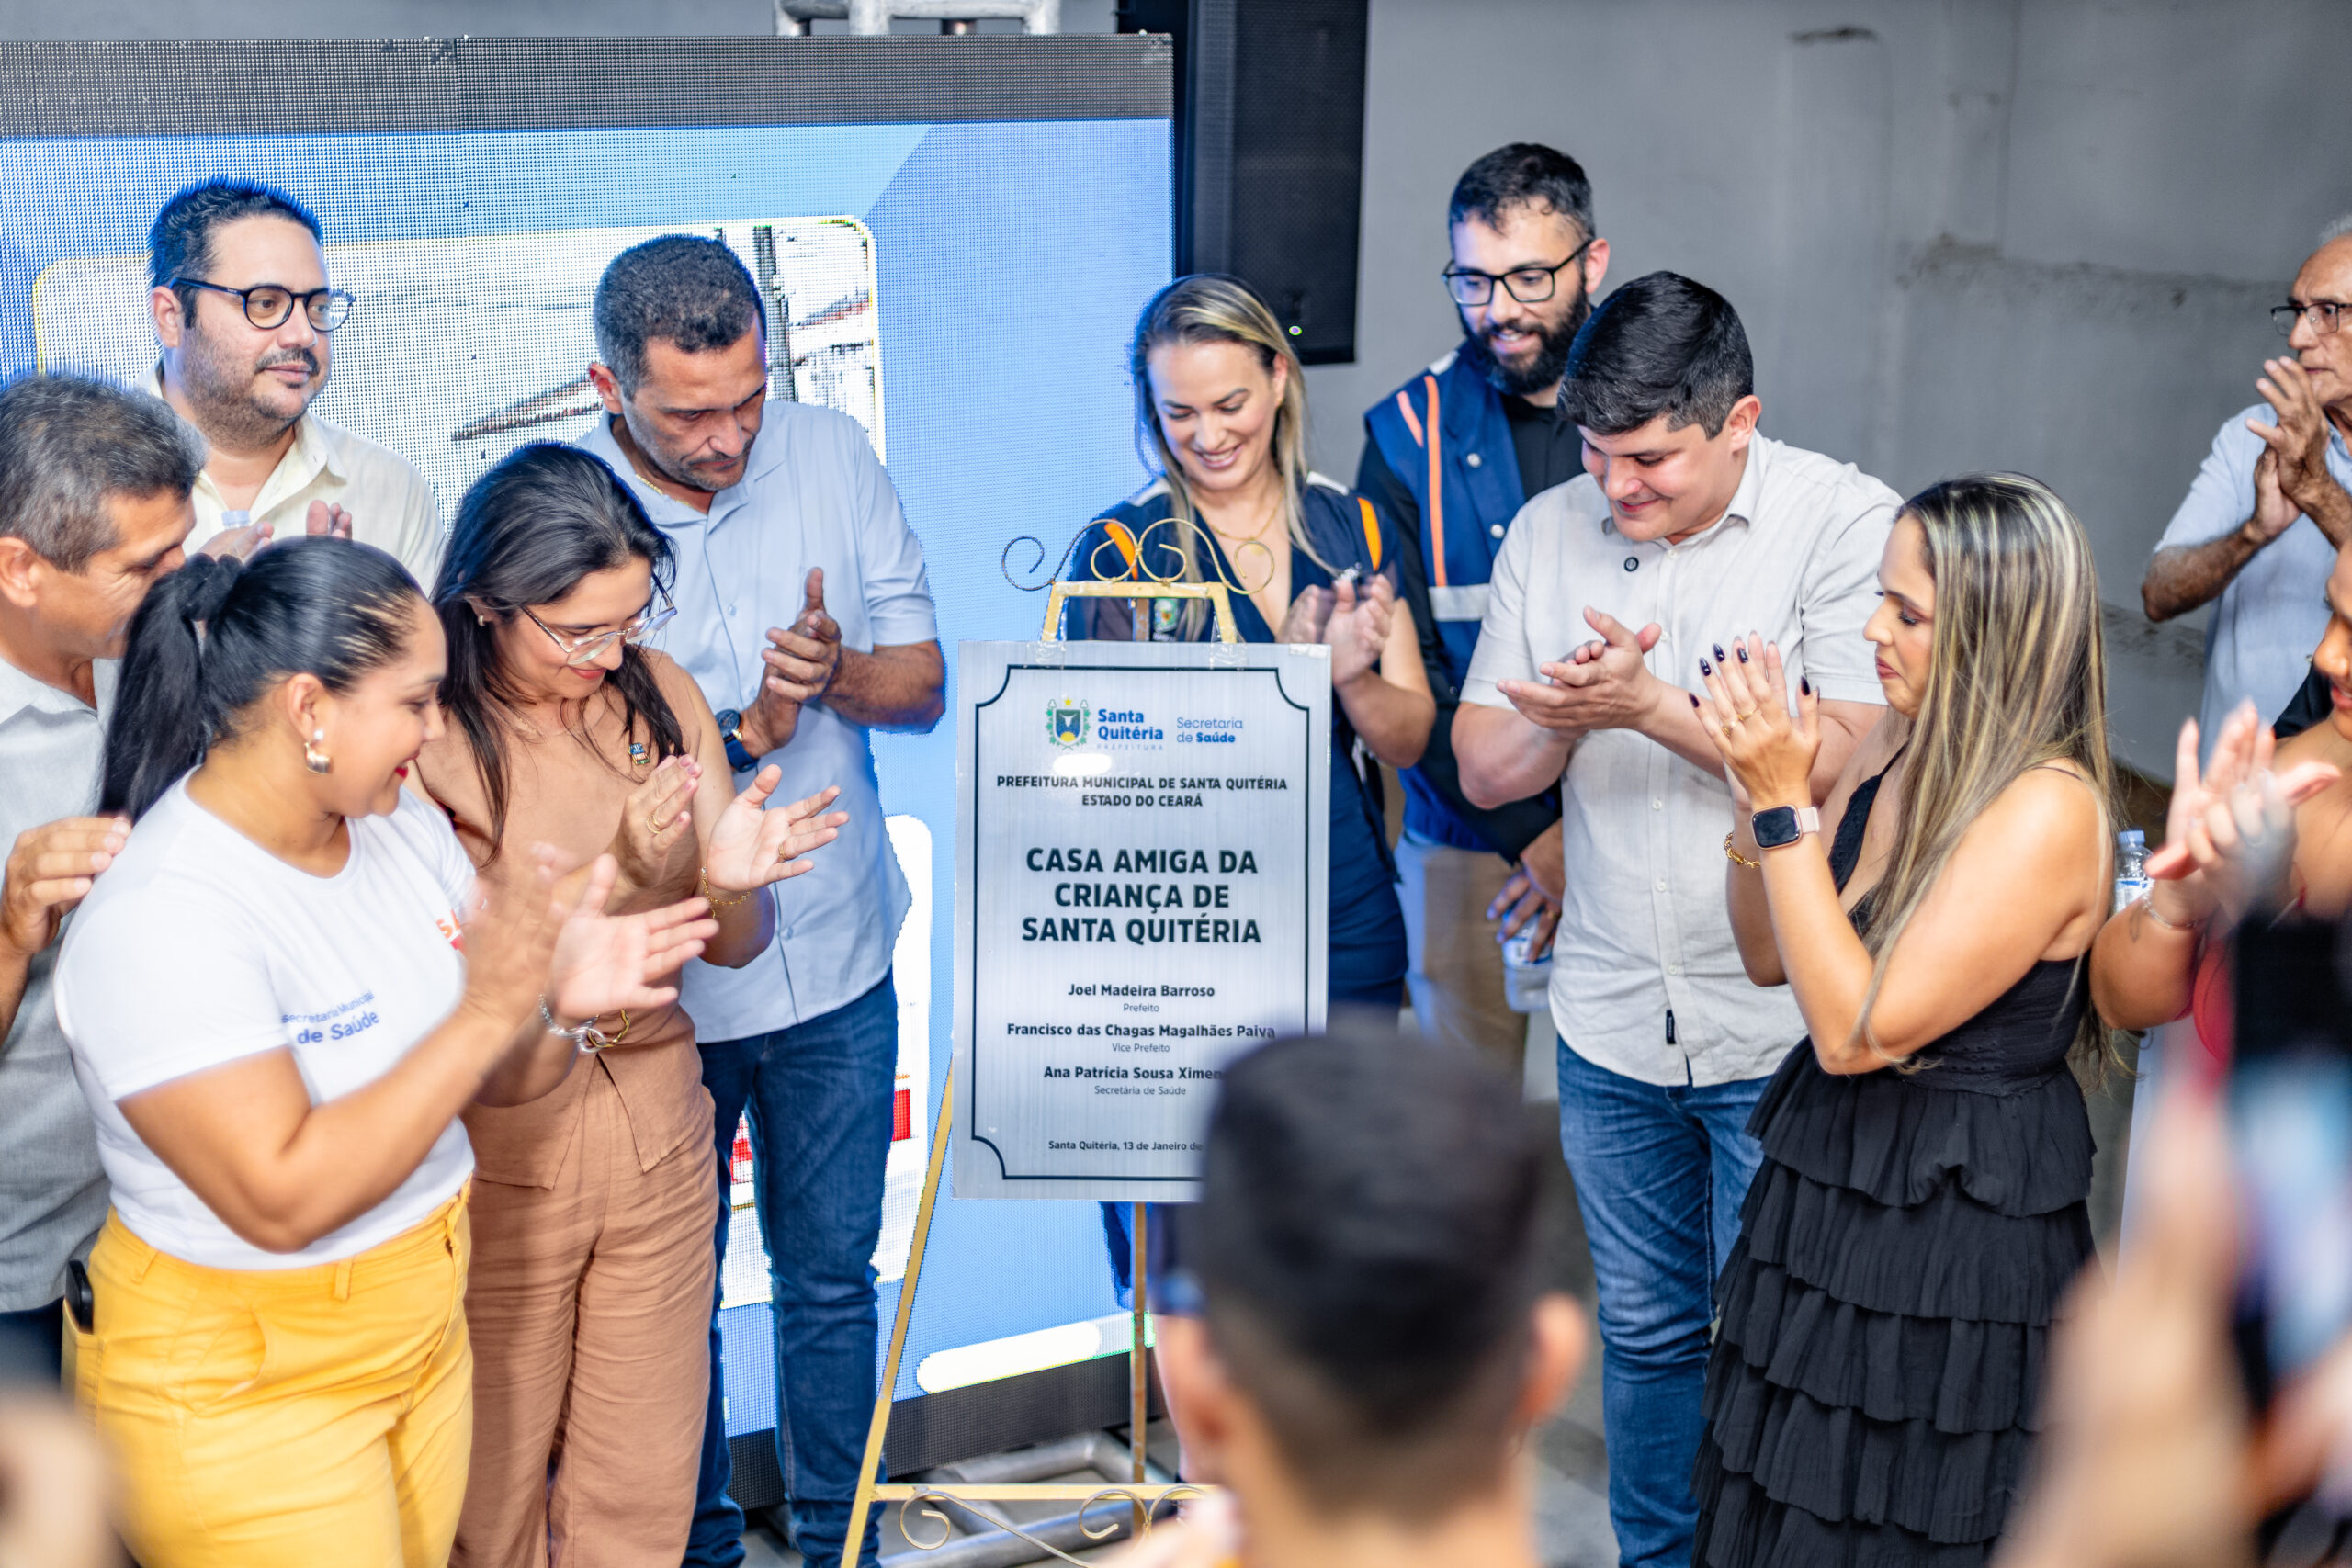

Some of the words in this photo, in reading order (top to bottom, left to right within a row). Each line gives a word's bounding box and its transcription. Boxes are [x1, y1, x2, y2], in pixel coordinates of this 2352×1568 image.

[1098, 709, 1145, 723] Santa
[1177, 717, 1243, 728] Secretaria
[1098, 726, 1163, 741] Quitéria
[1177, 731, 1193, 743] de
[1195, 731, 1236, 743] Saúde
[996, 775, 1079, 788] PREFEITURA
[1082, 776, 1154, 789] MUNICIPAL
[1159, 778, 1176, 789] DE
[1180, 778, 1222, 789] SANTA
[1225, 774, 1288, 791] QUITÉRIA
[1081, 795, 1132, 807] ESTADO
[1136, 795, 1155, 807] DO
[1158, 792, 1204, 807] CEARÁ
[1026, 848, 1104, 873] CASA
[1114, 849, 1209, 874] AMIGA
[1219, 850, 1259, 874] DA
[1055, 883, 1184, 914] CRIANÇA
[1193, 885, 1229, 909] DE
[1022, 918, 1117, 943] SANTA
[1125, 913, 1262, 946] QUITÉRIA
[1068, 984, 1097, 997] Joel
[1101, 984, 1157, 997] Madeira
[1160, 985, 1216, 998] Barroso
[1123, 1003, 1159, 1013] Prefeito
[297, 1028, 323, 1044] de
[330, 1010, 379, 1041] Saúde
[1007, 1023, 1072, 1036] Francisco
[1077, 1023, 1101, 1036] das
[1105, 1024, 1155, 1039] Chagas
[1159, 1024, 1233, 1039] Magalhães
[1237, 1024, 1276, 1039] Paiva
[1112, 1043, 1133, 1053] Vice
[1134, 1043, 1170, 1054] Prefeito
[1044, 1066, 1071, 1079] Ana
[1074, 1066, 1129, 1079] Patrícia
[1134, 1067, 1174, 1079] Sousa
[1178, 1067, 1224, 1079] Ximen
[1094, 1085, 1141, 1096] Secretária
[1143, 1086, 1156, 1096] de
[1158, 1086, 1186, 1096] Saúde
[1048, 1141, 1076, 1150] Santa
[1079, 1140, 1120, 1152] Quitéria,
[1123, 1141, 1134, 1151] 13
[1136, 1141, 1149, 1151] de
[1151, 1141, 1188, 1152] Janeiro
[1190, 1141, 1203, 1152] de
